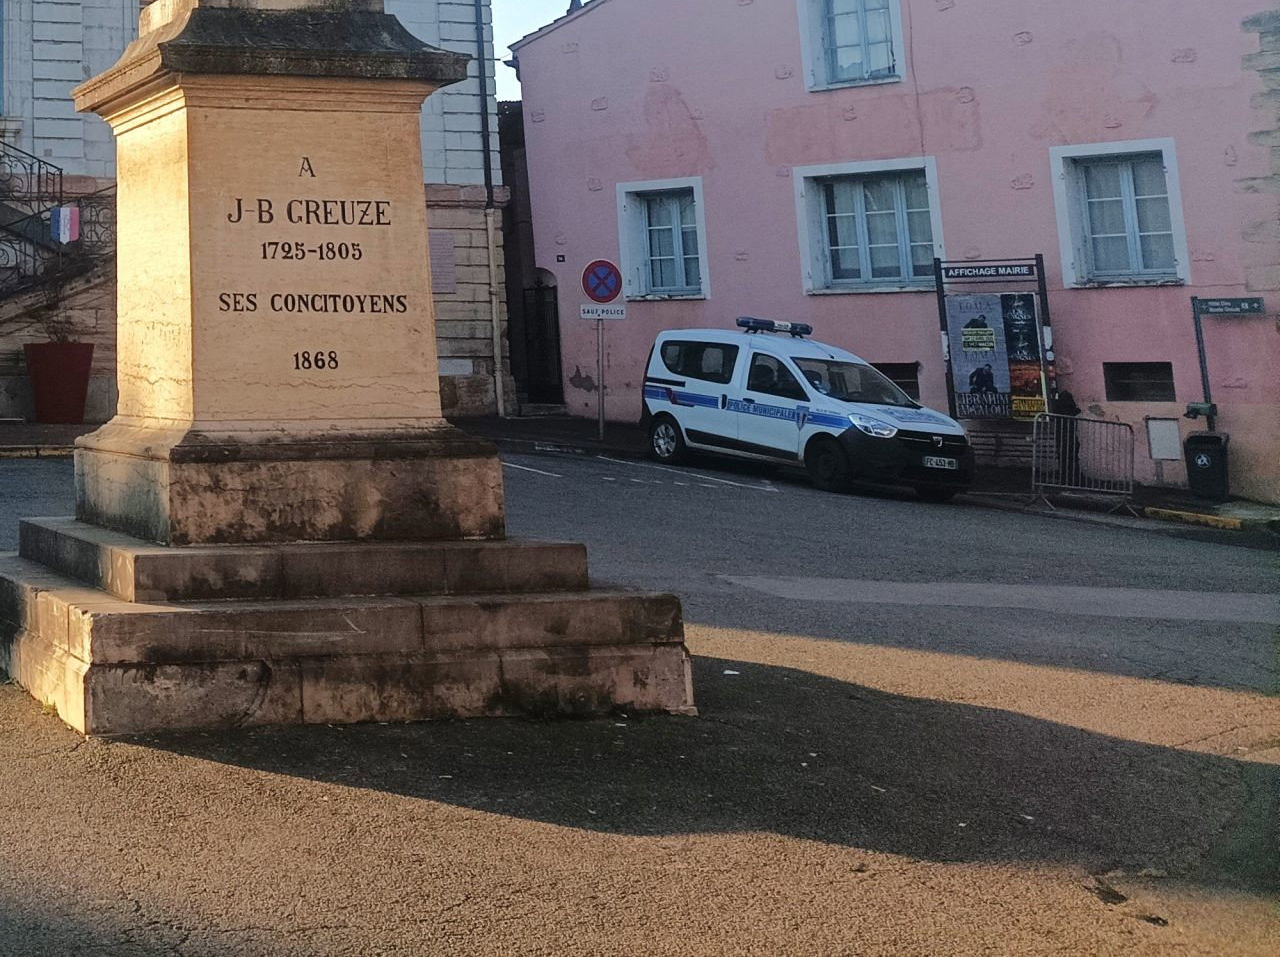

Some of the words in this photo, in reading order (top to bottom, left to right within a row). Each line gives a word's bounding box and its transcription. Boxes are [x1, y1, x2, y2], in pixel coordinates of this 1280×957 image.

[298, 156, 316, 177] A
[286, 199, 391, 226] GREUZE
[261, 242, 363, 260] 1725-1805
[948, 268, 997, 276] AFFICHAGE
[998, 266, 1029, 275] MAIRIE
[218, 292, 257, 312] SES
[270, 293, 408, 314] CONCITOYENS
[293, 350, 339, 370] 1868
[728, 400, 752, 412] POLICE
[753, 403, 794, 419] MUNICIPALE
